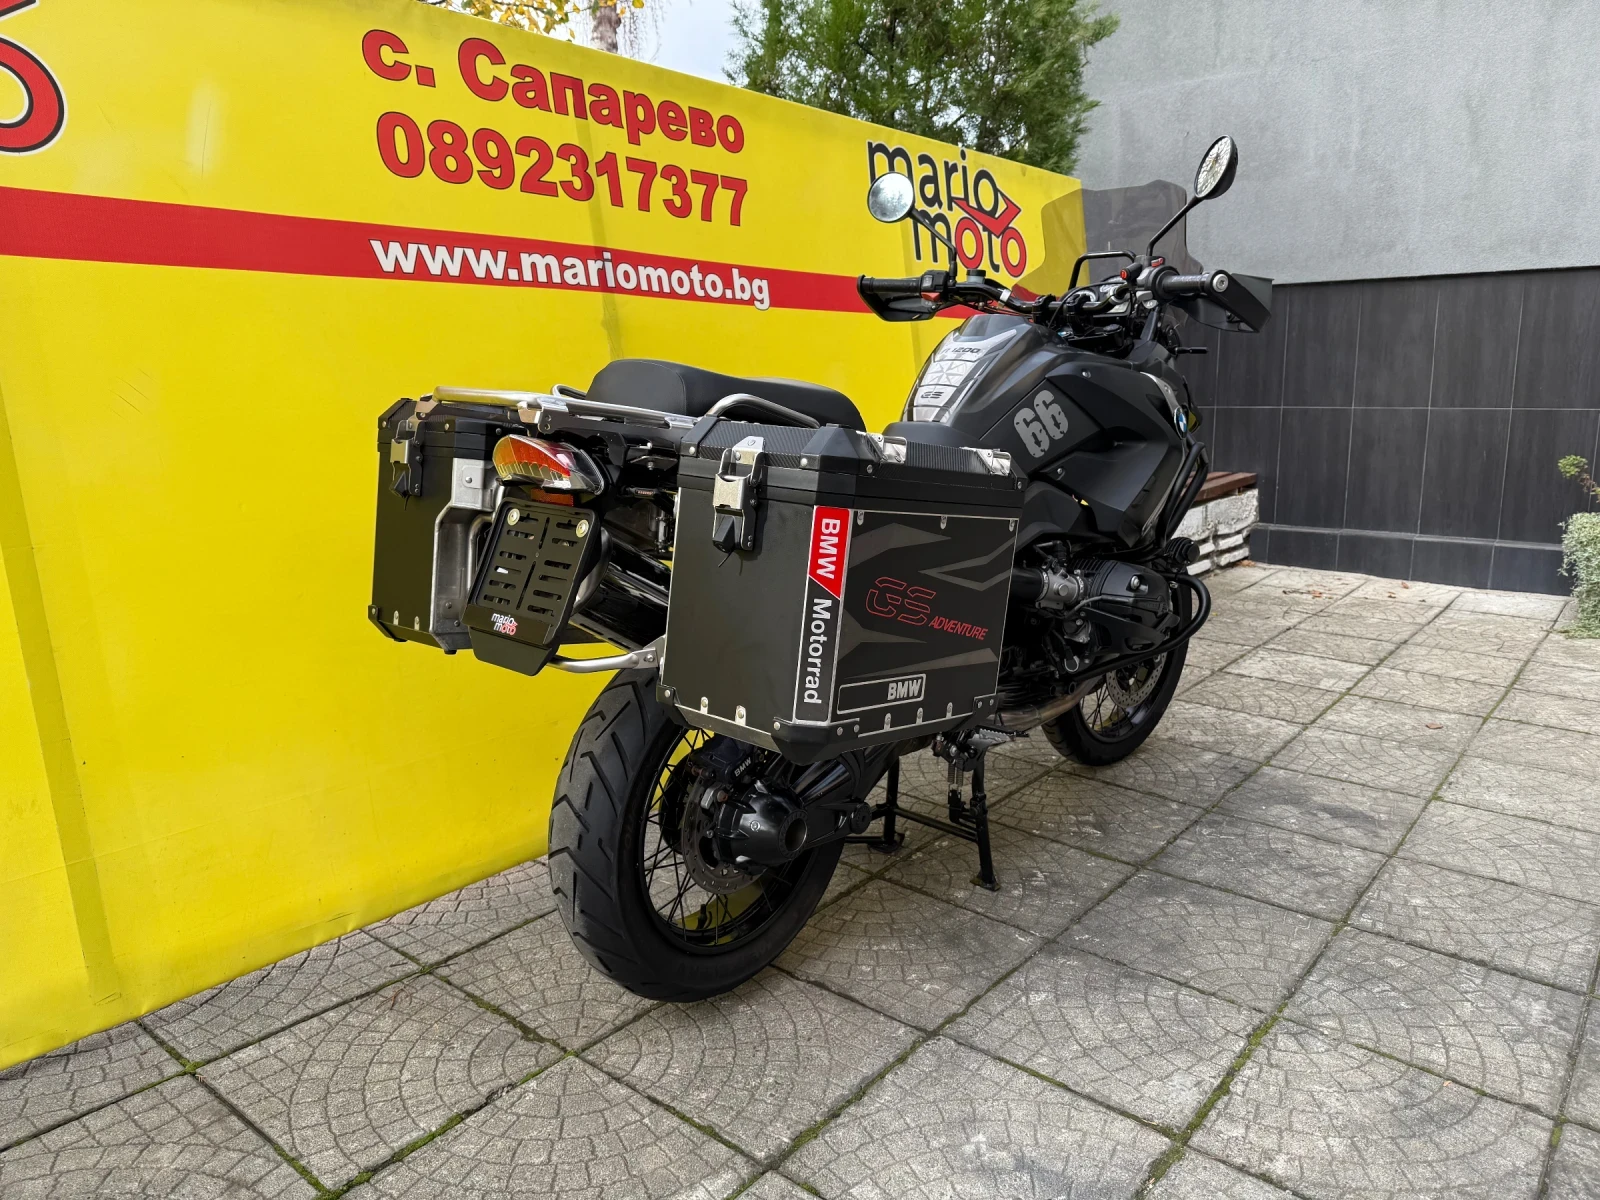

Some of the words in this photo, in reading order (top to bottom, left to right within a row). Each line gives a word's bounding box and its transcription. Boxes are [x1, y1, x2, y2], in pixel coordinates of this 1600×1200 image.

[361, 29, 437, 88] с.
[457, 37, 745, 154] Сапарево
[376, 110, 749, 227] 0892317377
[369, 238, 771, 311] www.mariomoto.bg
[912, 209, 1027, 278] moto
[1013, 389, 1070, 459] 66
[816, 518, 841, 580] BMW
[491, 613, 515, 626] mario
[865, 576, 937, 627] GS
[928, 615, 989, 641] ADVENTURE
[803, 598, 833, 705] Motorrad
[886, 679, 923, 701] BMW
[734, 757, 752, 778] BMW
